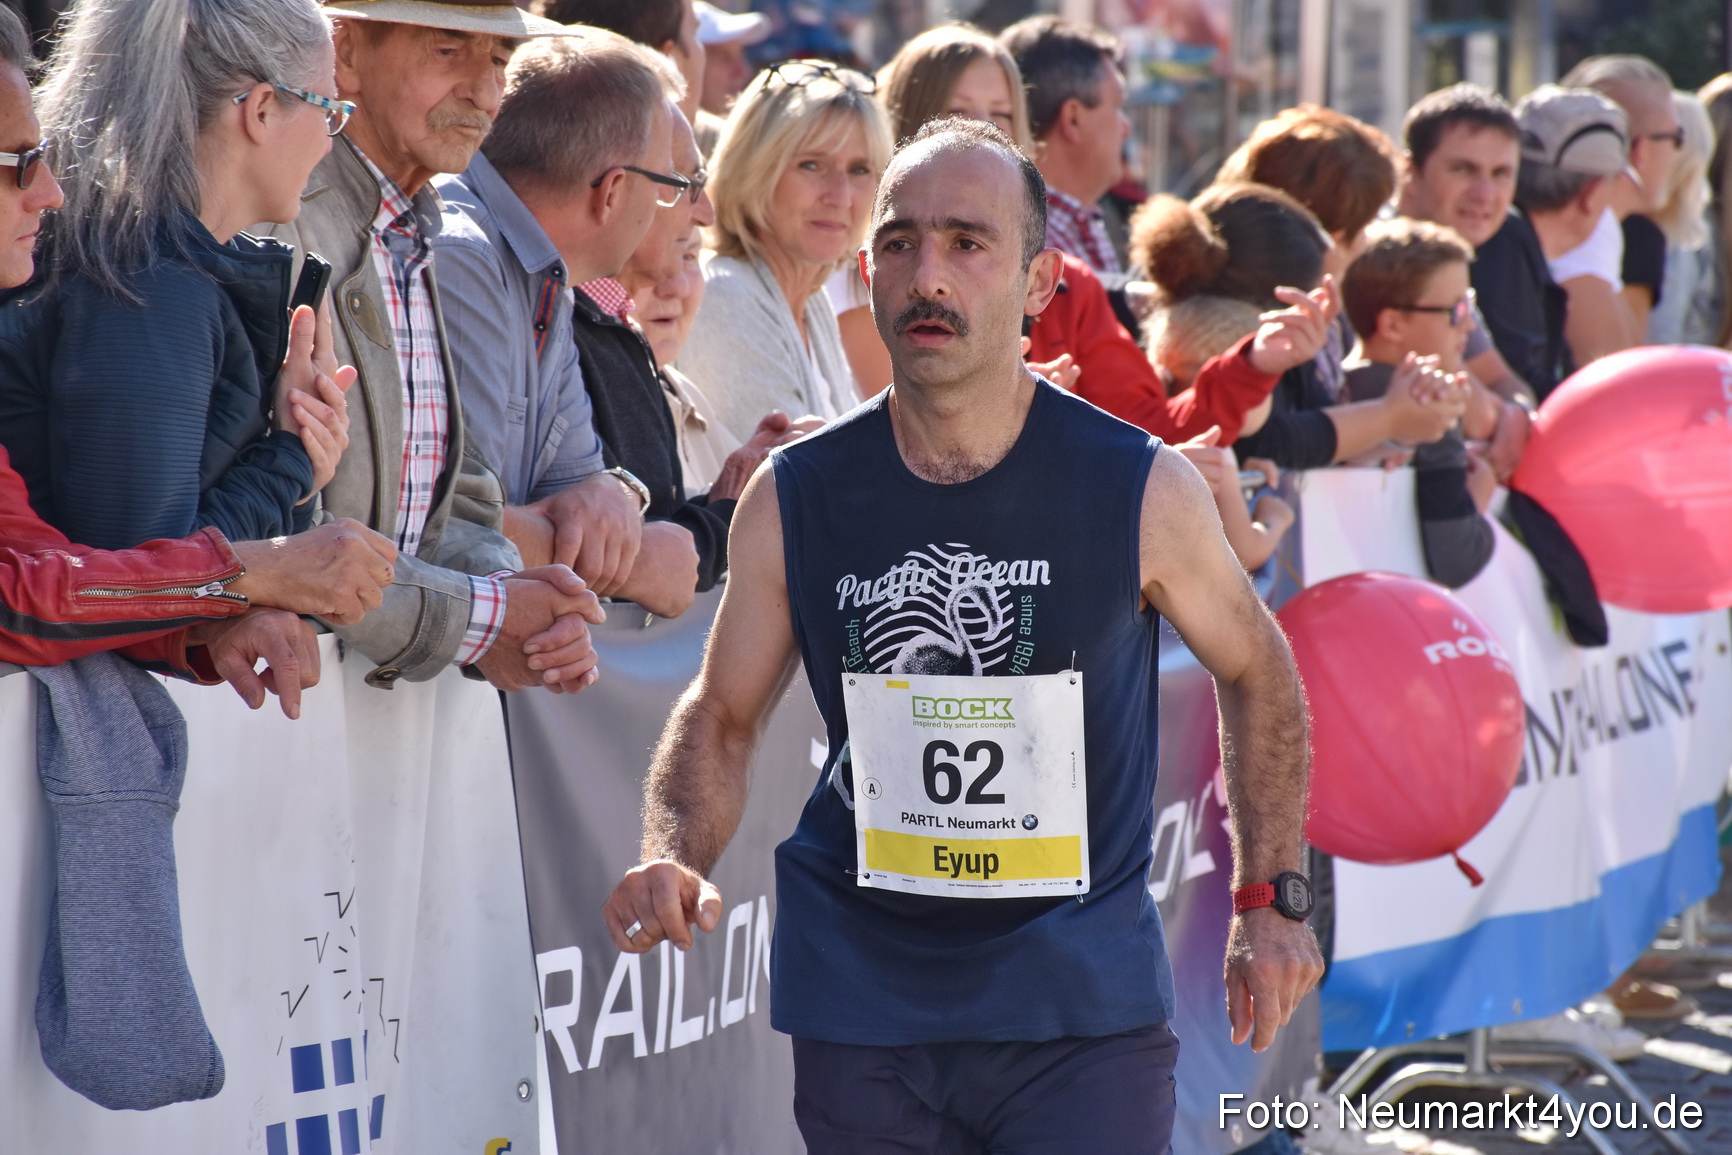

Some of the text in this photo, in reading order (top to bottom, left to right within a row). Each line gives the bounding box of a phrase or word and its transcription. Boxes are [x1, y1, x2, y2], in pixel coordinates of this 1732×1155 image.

[836, 552, 1051, 610] Pacific Ocean
[845, 619, 864, 668] Beach
[1009, 595, 1036, 675] since 1994
[912, 696, 1015, 720] BOCK
[912, 719, 1016, 729] inspired by smart concepts
[867, 782, 877, 795] A
[922, 739, 1006, 805] 62
[901, 811, 945, 829] PARTL
[947, 817, 1016, 829] Neumarkt
[933, 845, 1000, 879] Eyup
